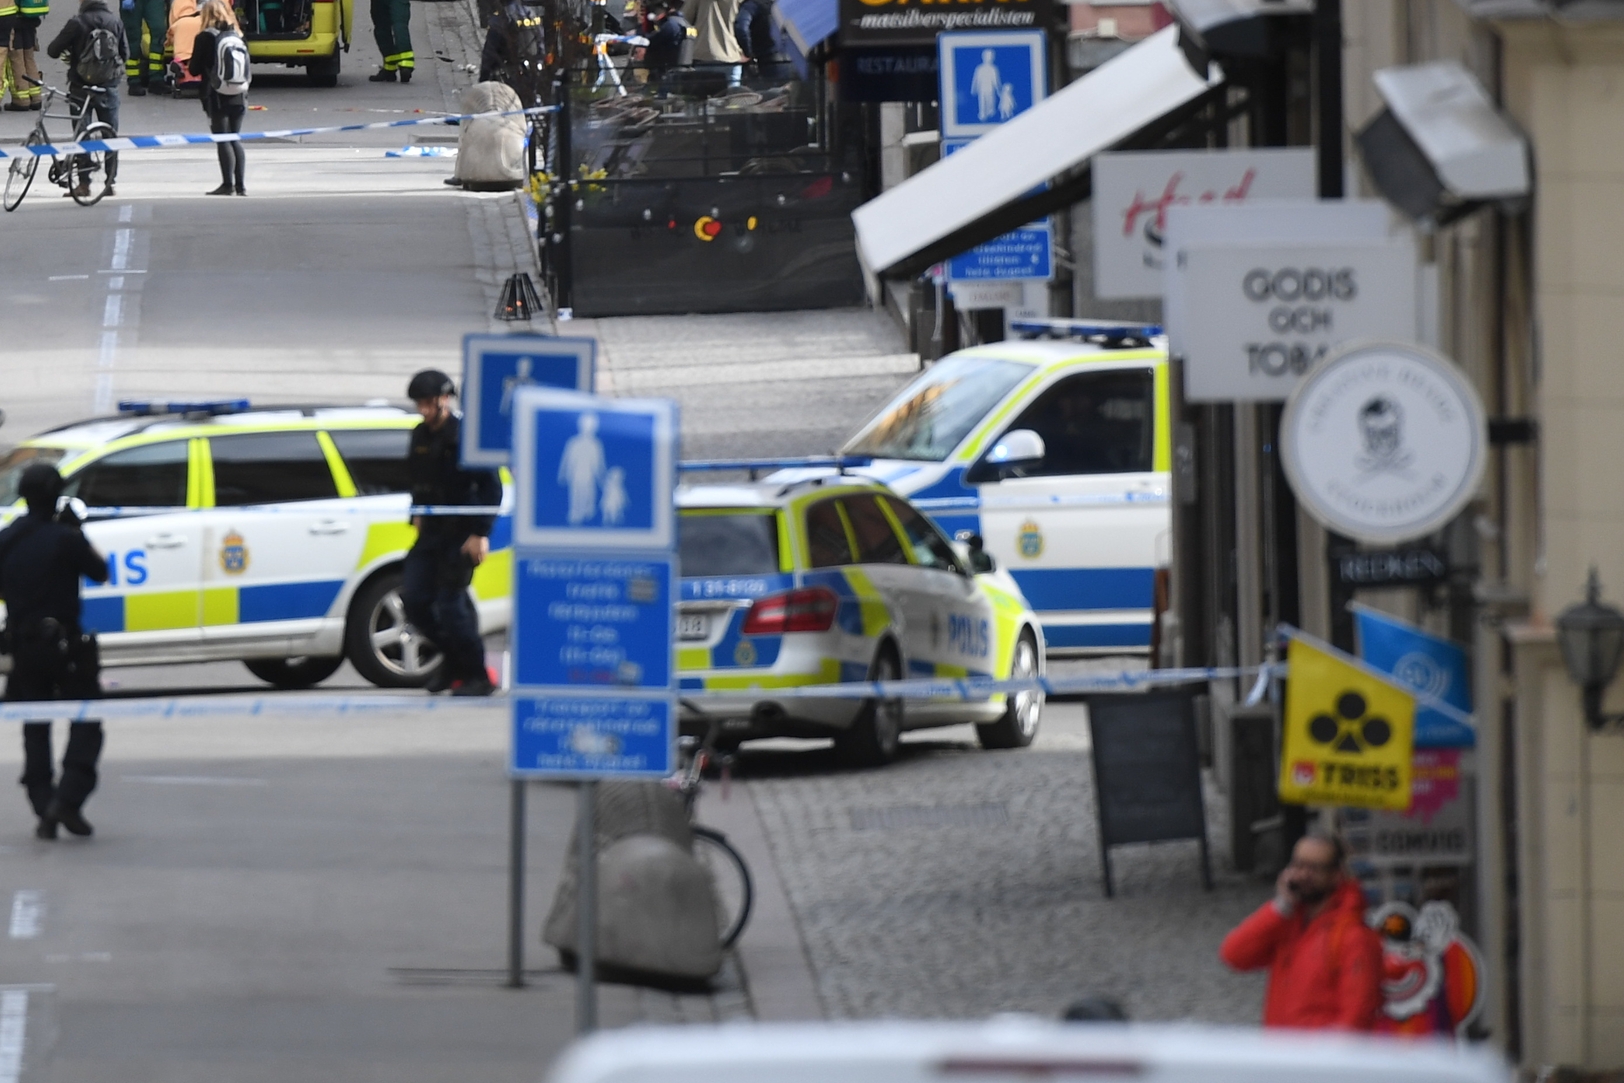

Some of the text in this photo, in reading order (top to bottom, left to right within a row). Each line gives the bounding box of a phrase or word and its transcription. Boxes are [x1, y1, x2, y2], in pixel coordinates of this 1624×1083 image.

[1242, 266, 1358, 302] GODIS
[1267, 308, 1334, 335] OCH
[947, 613, 989, 658] POLIS
